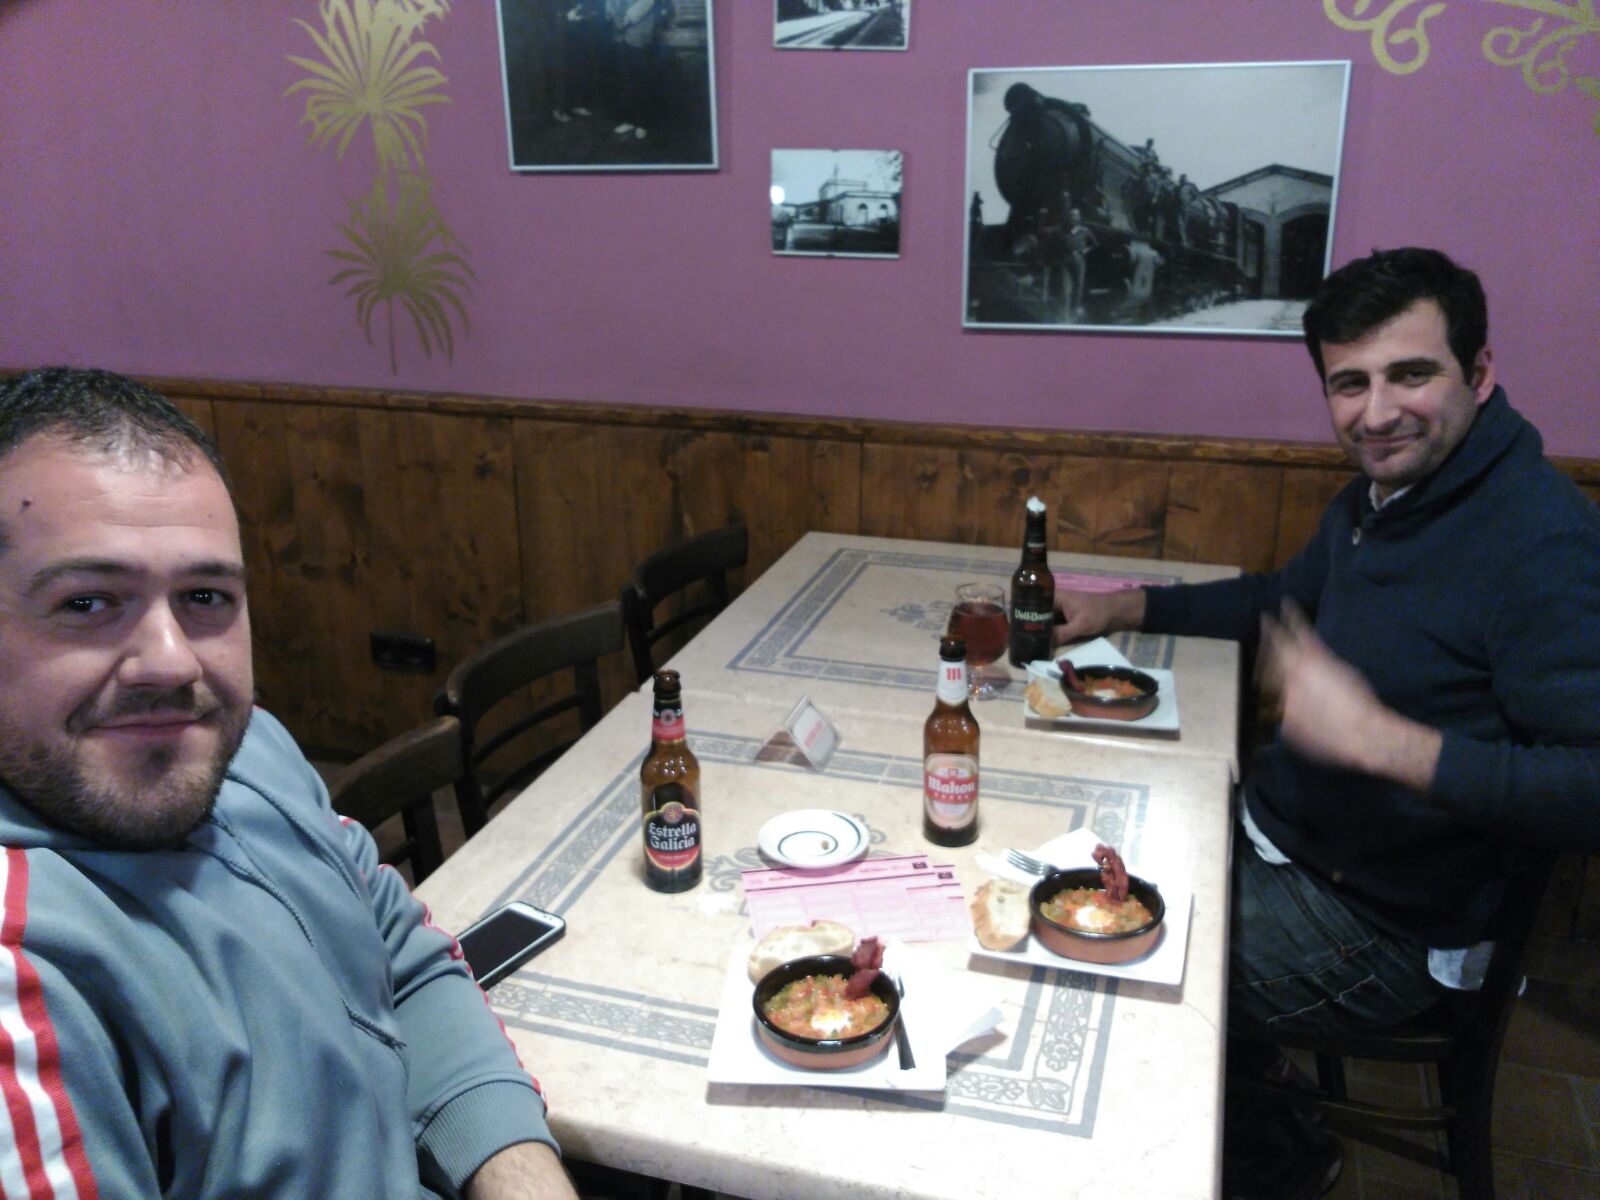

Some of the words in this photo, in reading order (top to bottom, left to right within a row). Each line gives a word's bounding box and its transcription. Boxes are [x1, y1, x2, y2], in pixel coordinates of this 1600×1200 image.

[927, 776, 975, 794] Mahou
[648, 822, 697, 838] Estrella
[650, 835, 696, 851] Galicia
